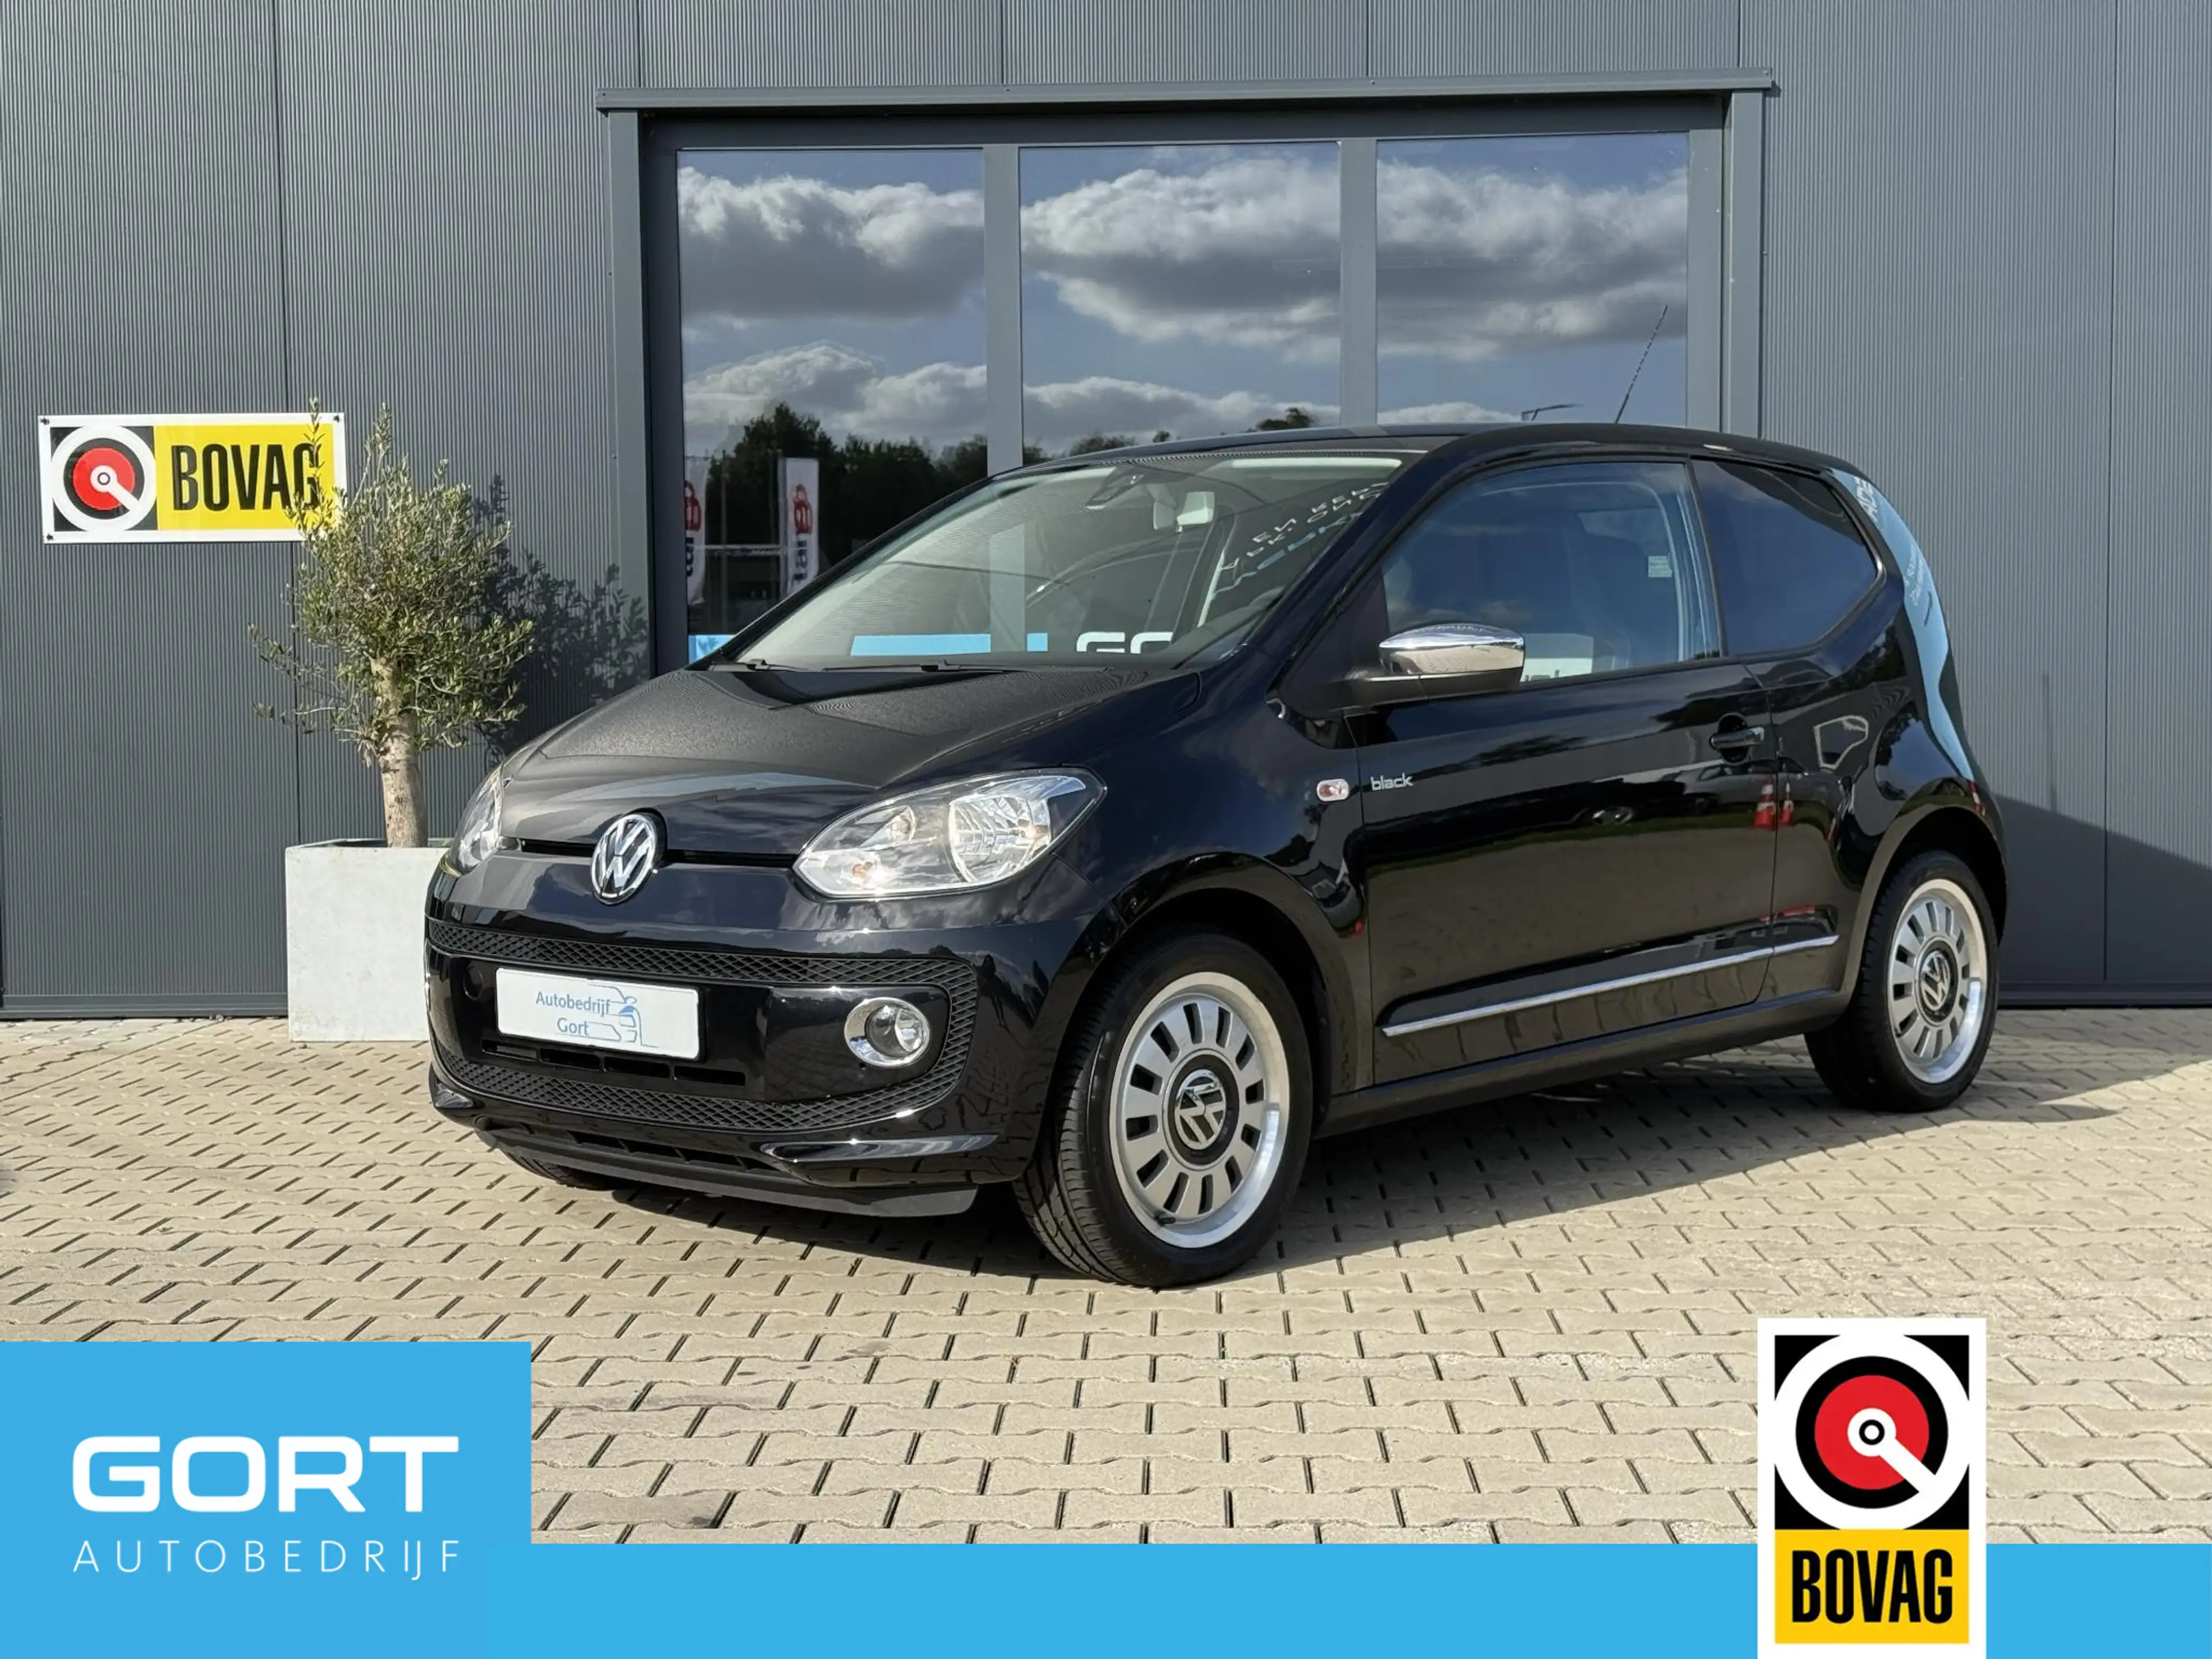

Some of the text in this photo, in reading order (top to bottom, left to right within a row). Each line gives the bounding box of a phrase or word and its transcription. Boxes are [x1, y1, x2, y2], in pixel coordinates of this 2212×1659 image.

[172, 443, 321, 511] BOVAG
[1370, 772, 1413, 791] black
[535, 991, 611, 1018] Autobedrijf
[556, 1017, 589, 1036] Gort
